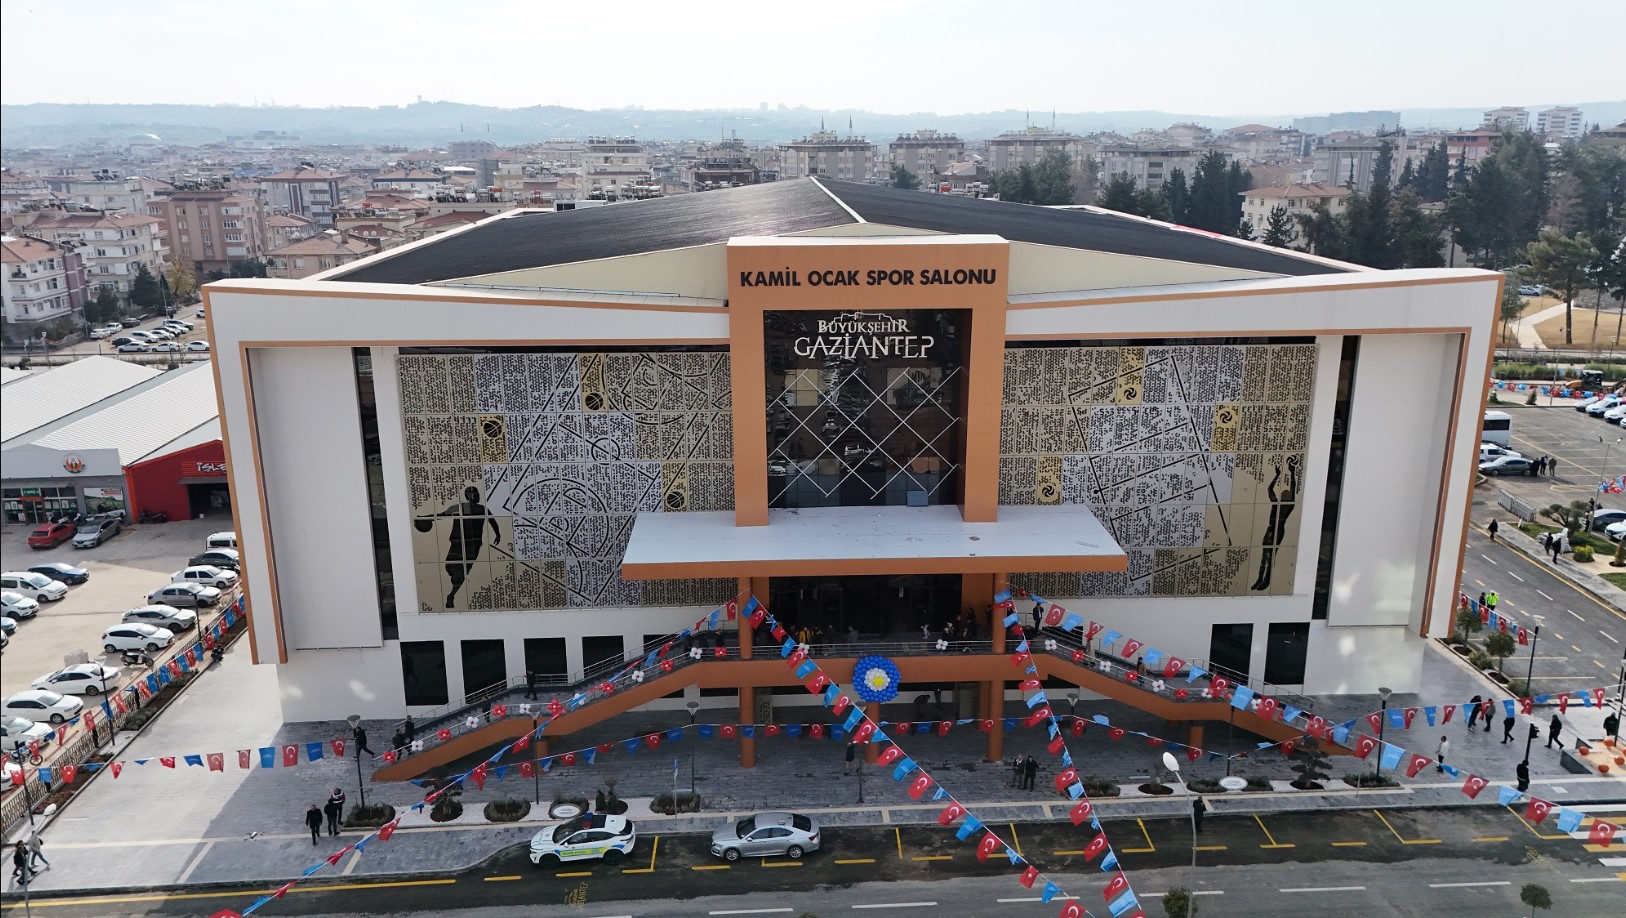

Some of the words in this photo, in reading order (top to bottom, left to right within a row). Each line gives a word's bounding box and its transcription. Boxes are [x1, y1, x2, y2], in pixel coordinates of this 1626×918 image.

[741, 267, 801, 286] KAMİL
[807, 270, 860, 286] OCAK
[867, 269, 914, 286] SPOR
[920, 269, 996, 285] SALONU
[794, 334, 935, 359] GAZİANTEP
